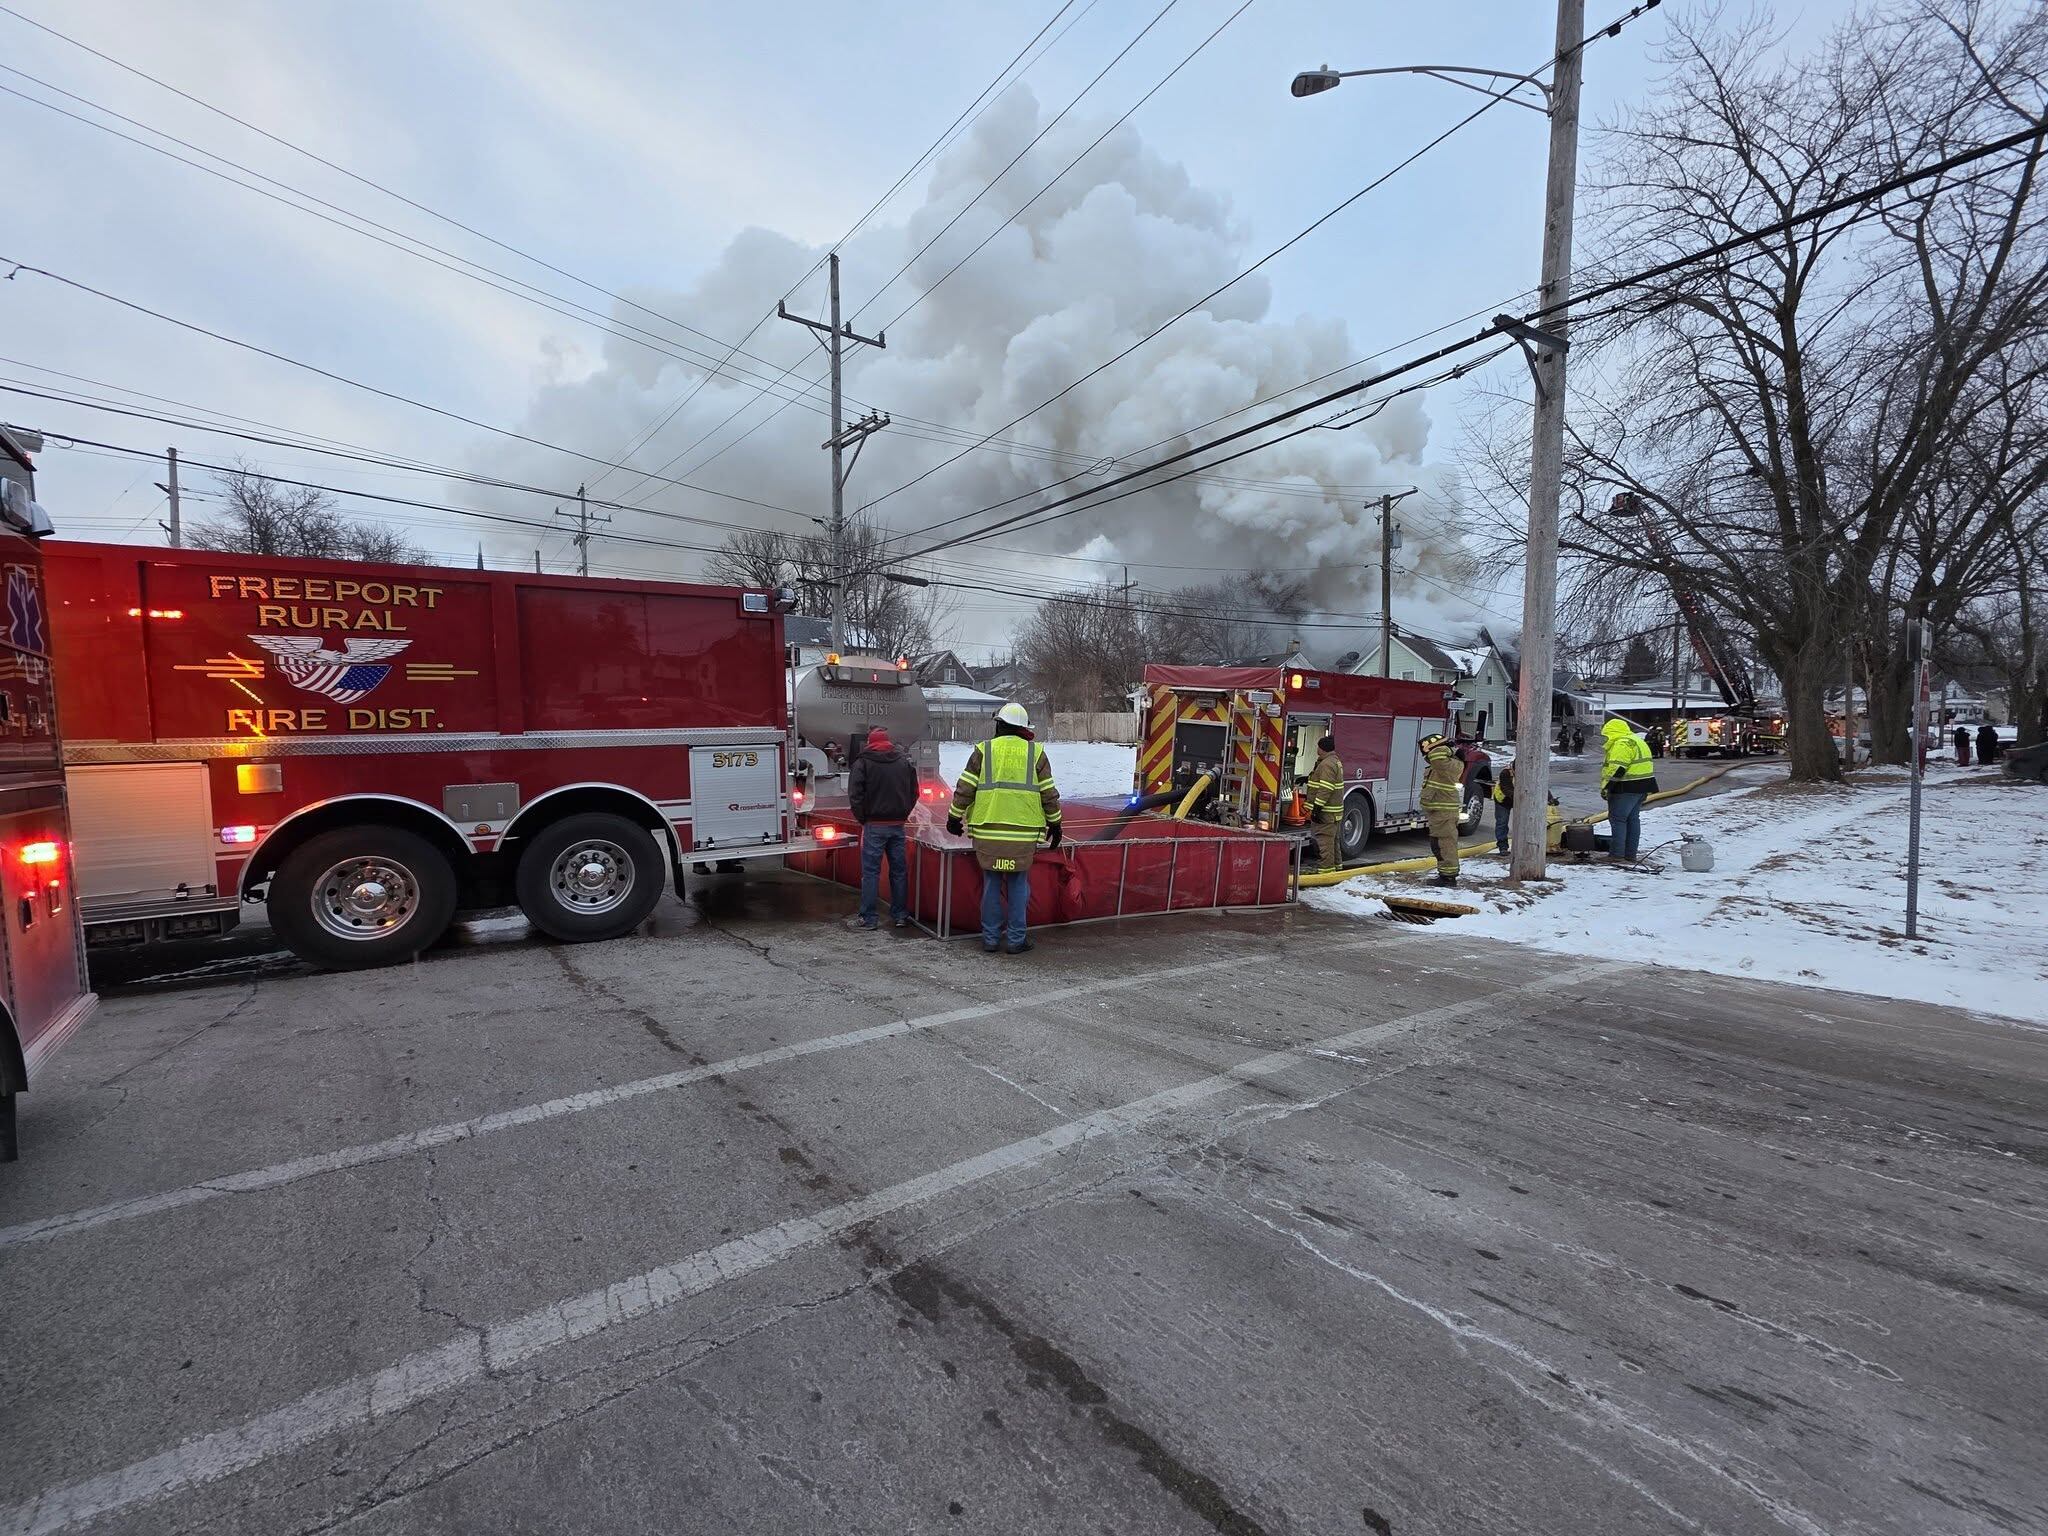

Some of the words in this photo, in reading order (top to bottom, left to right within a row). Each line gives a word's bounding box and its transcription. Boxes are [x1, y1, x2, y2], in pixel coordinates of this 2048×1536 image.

[209, 575, 444, 608] FREEPORT
[258, 605, 407, 631] RURAL
[842, 702, 864, 715] FIRE
[227, 709, 328, 731] FIRE
[348, 708, 445, 729] DIST.
[992, 746, 1027, 757] REEPOR
[712, 752, 759, 768] 3173
[992, 859, 1016, 870] JURS
